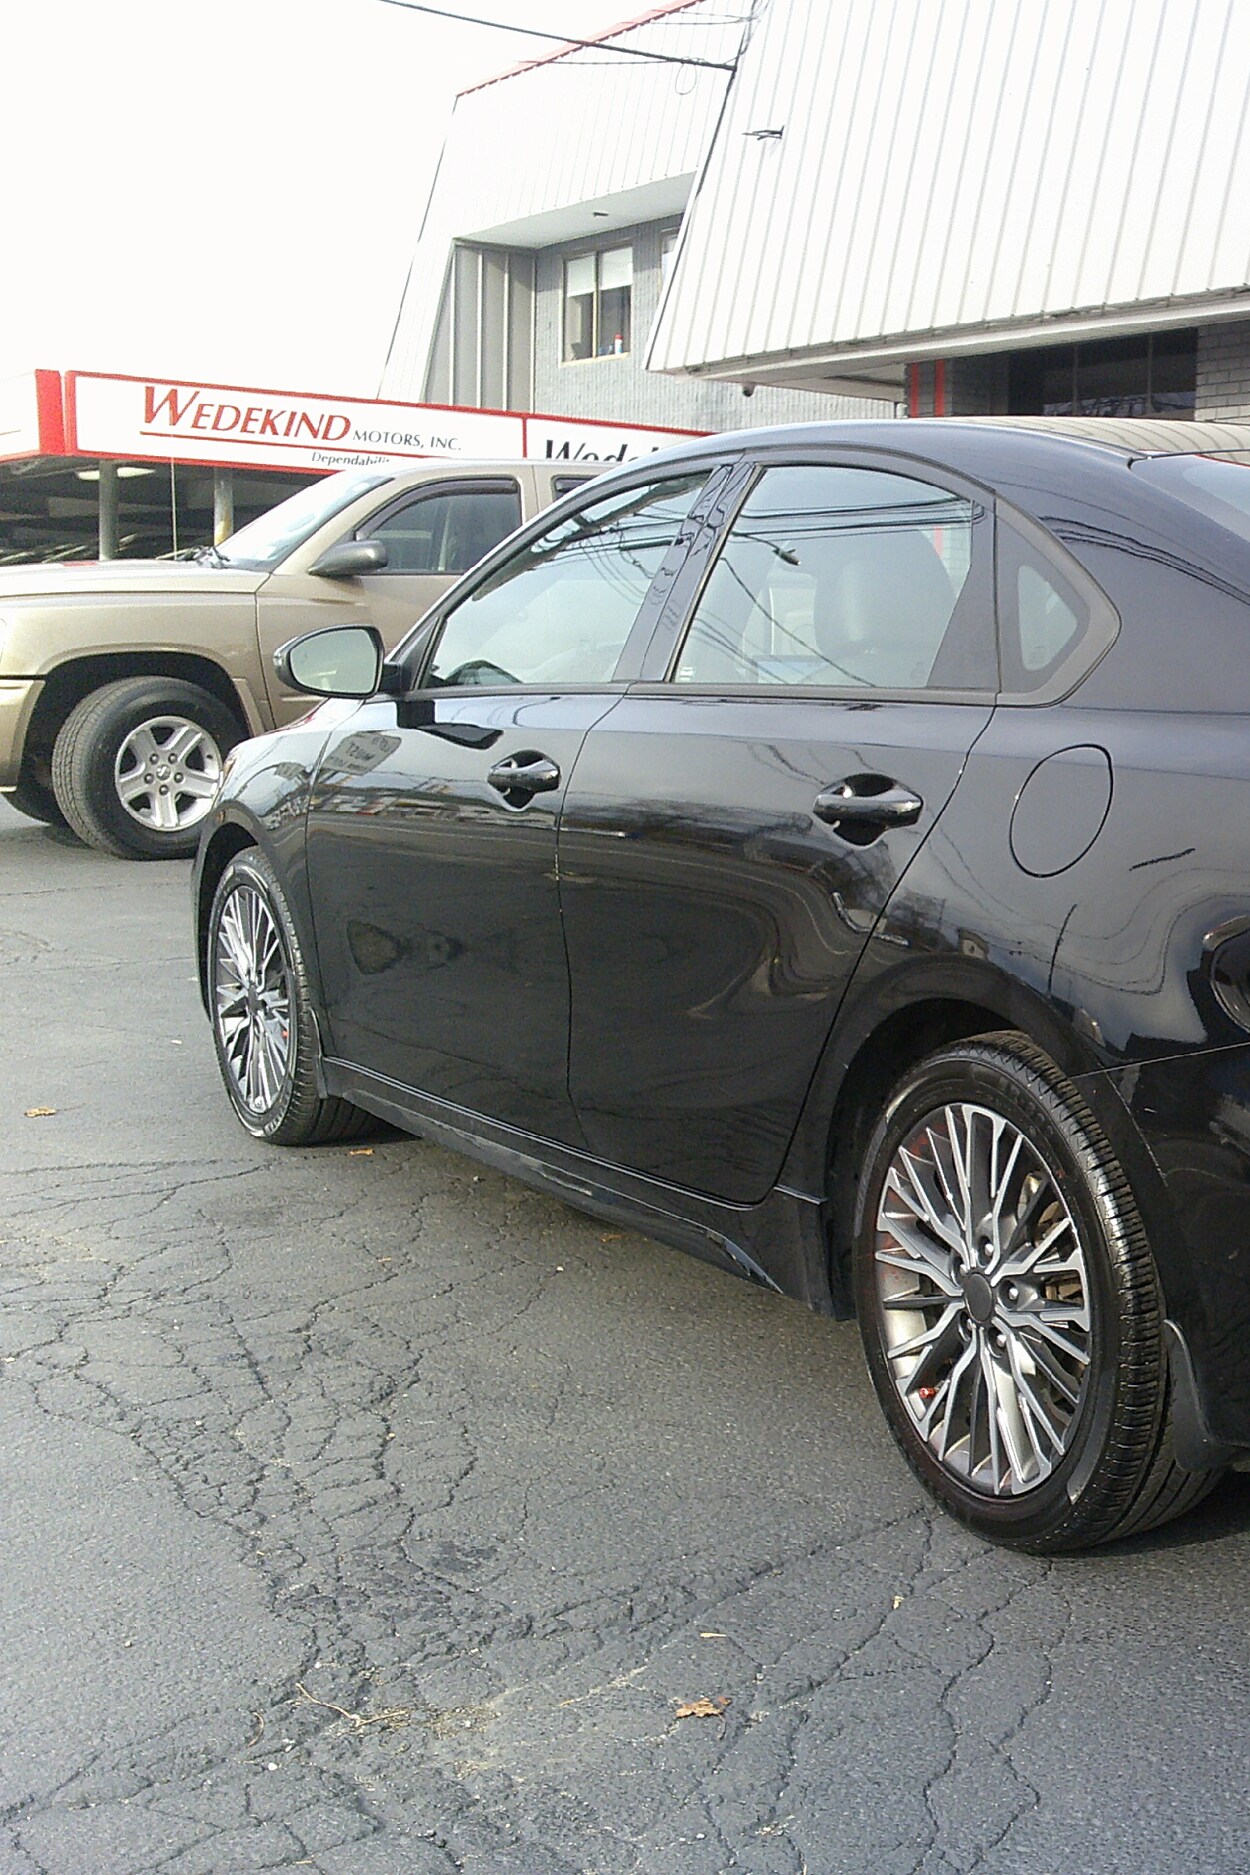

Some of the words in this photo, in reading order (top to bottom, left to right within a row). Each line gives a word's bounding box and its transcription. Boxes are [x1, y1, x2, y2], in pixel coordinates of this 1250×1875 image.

[144, 385, 352, 441] WEDEKIND
[352, 429, 425, 449] MOTORS,
[430, 436, 462, 451] INC.
